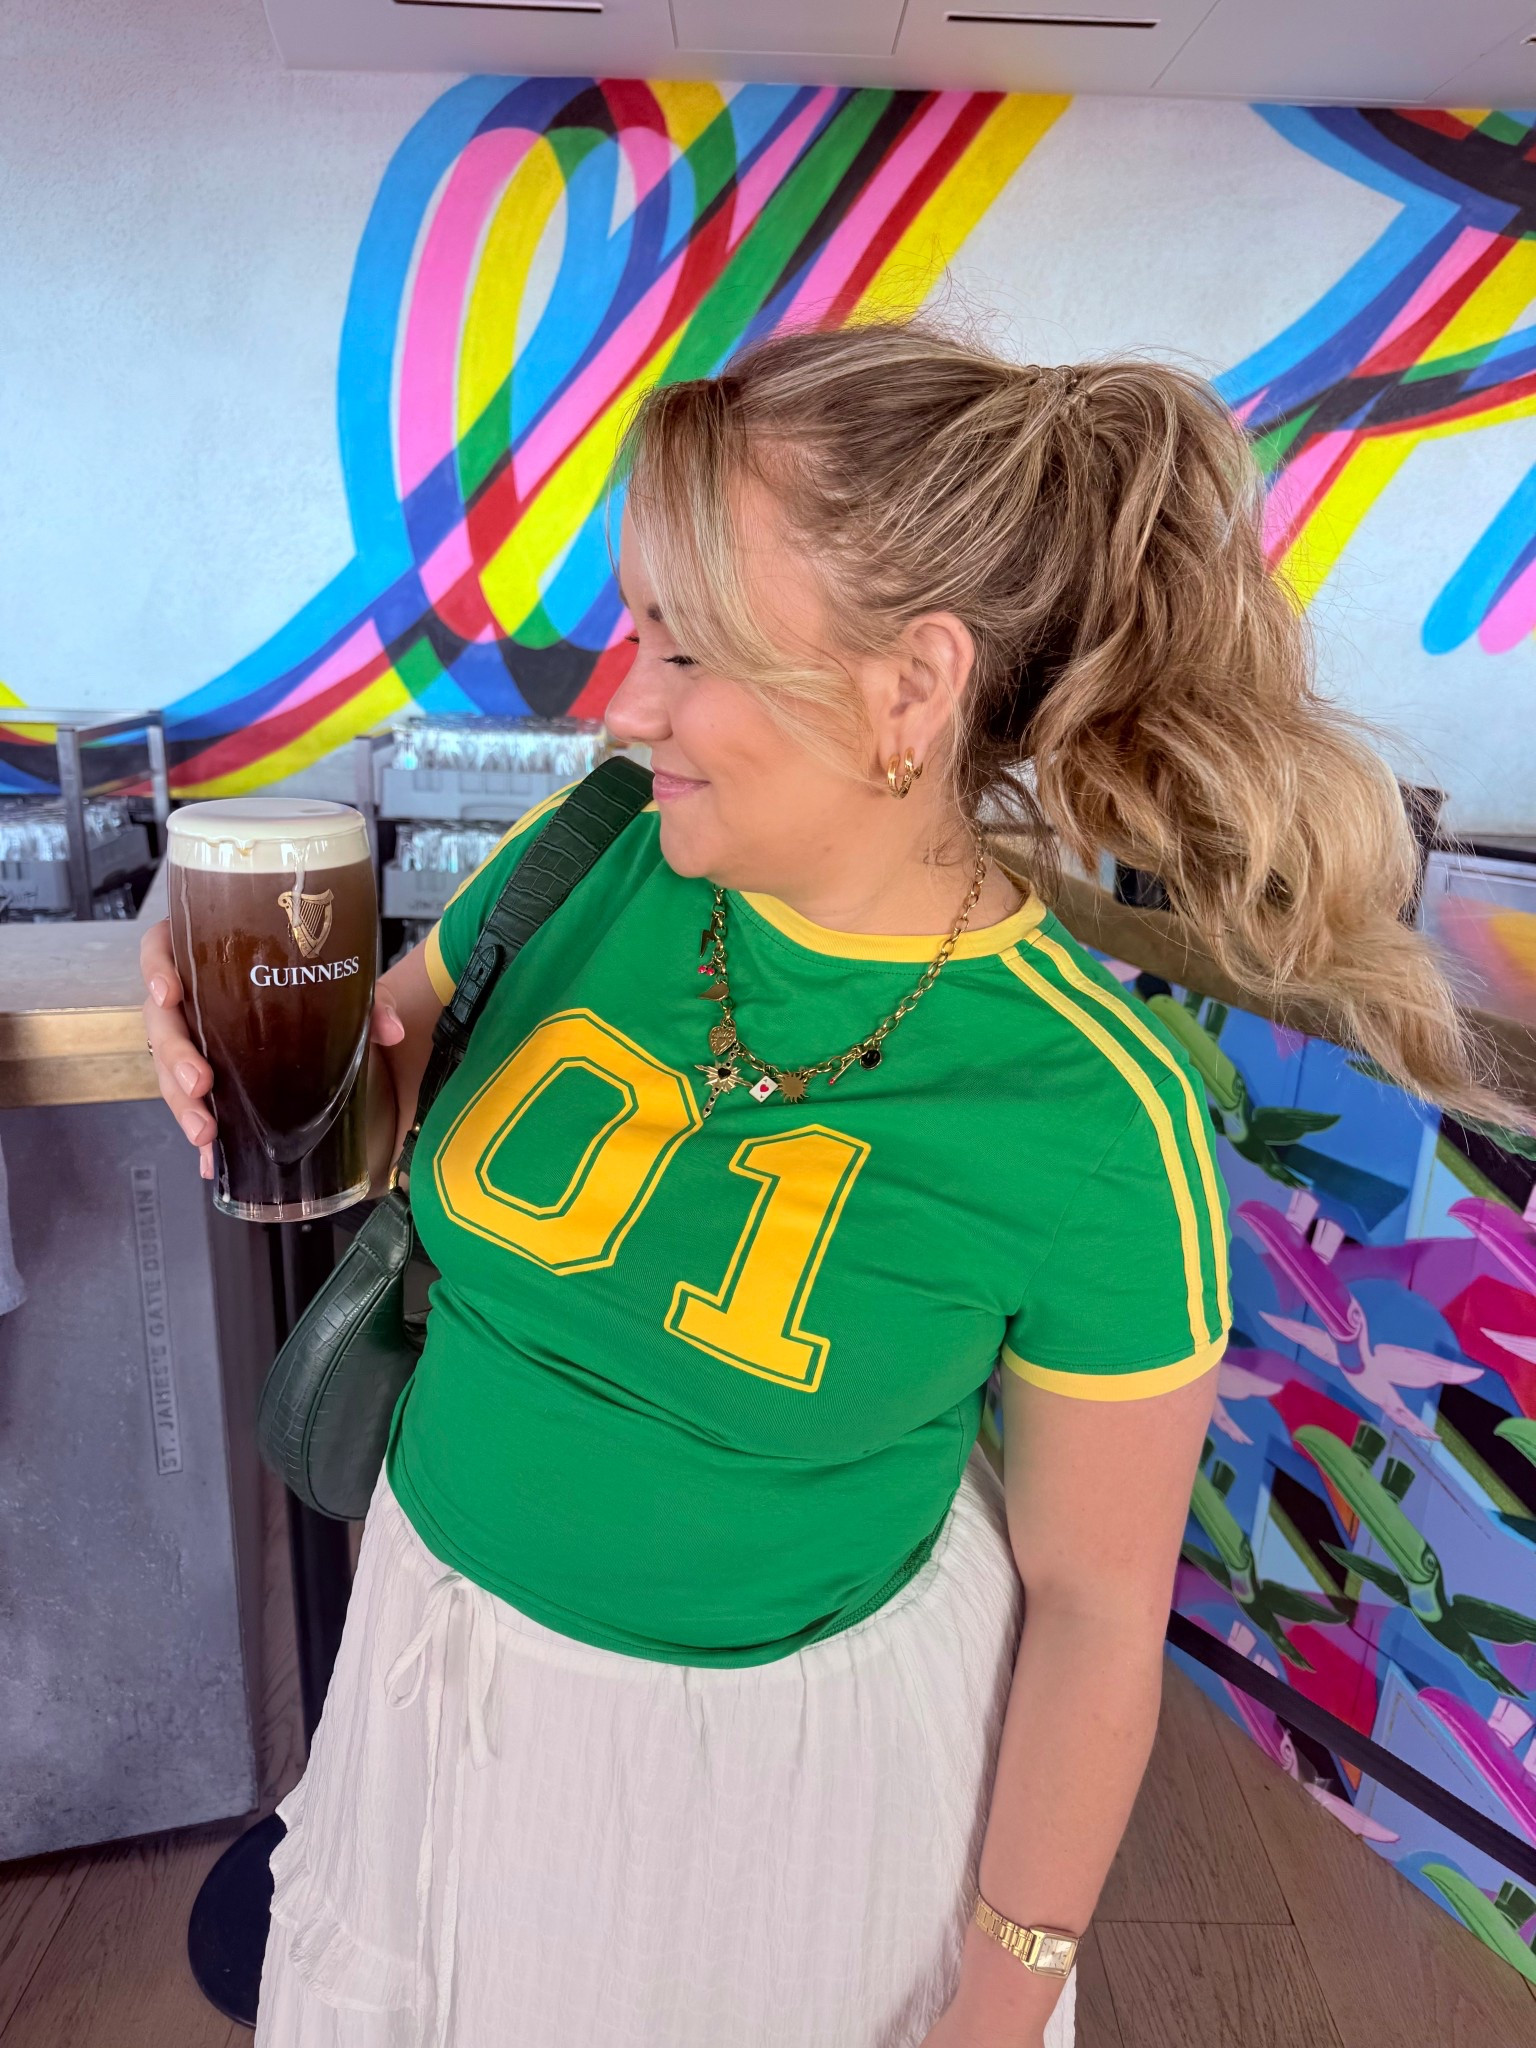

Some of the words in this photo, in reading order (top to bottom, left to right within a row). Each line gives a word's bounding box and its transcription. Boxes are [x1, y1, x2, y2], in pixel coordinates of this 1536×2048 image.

[250, 956, 360, 987] GUINNESS
[137, 1189, 159, 1272] DUBLIN
[433, 1008, 871, 1393] 01
[145, 1278, 165, 1338] GATE
[161, 1438, 178, 1469] ST.
